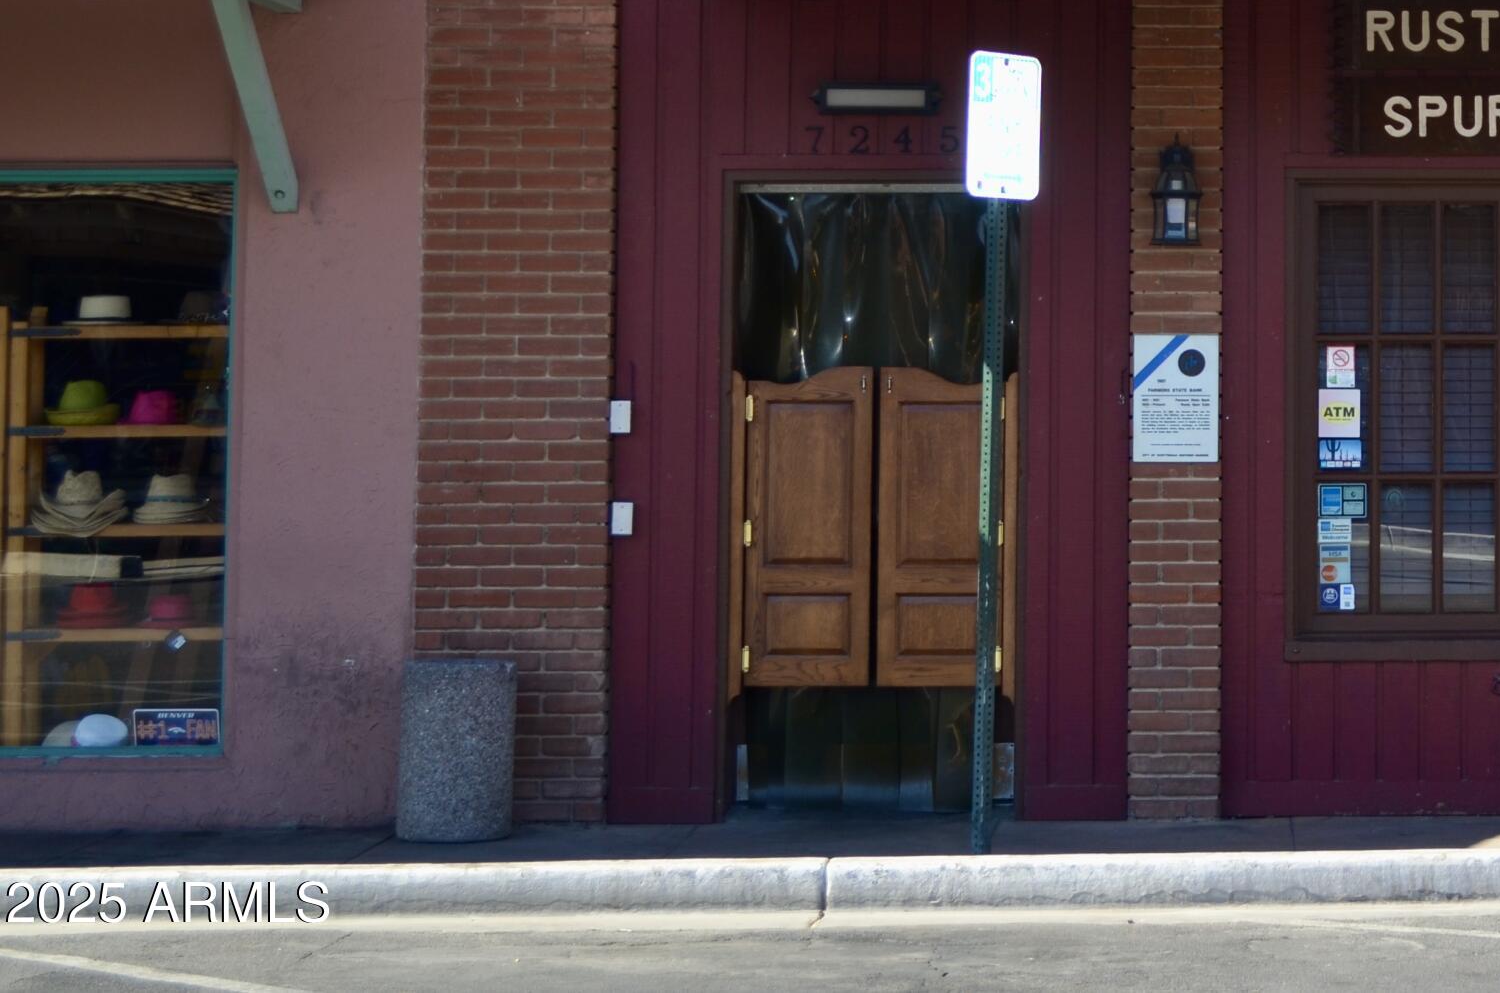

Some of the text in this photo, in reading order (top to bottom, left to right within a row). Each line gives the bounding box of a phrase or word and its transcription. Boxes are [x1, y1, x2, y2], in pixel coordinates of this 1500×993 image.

[804, 125, 961, 155] 7245
[1323, 406, 1356, 418] ATM
[137, 719, 217, 740] #1 FAN
